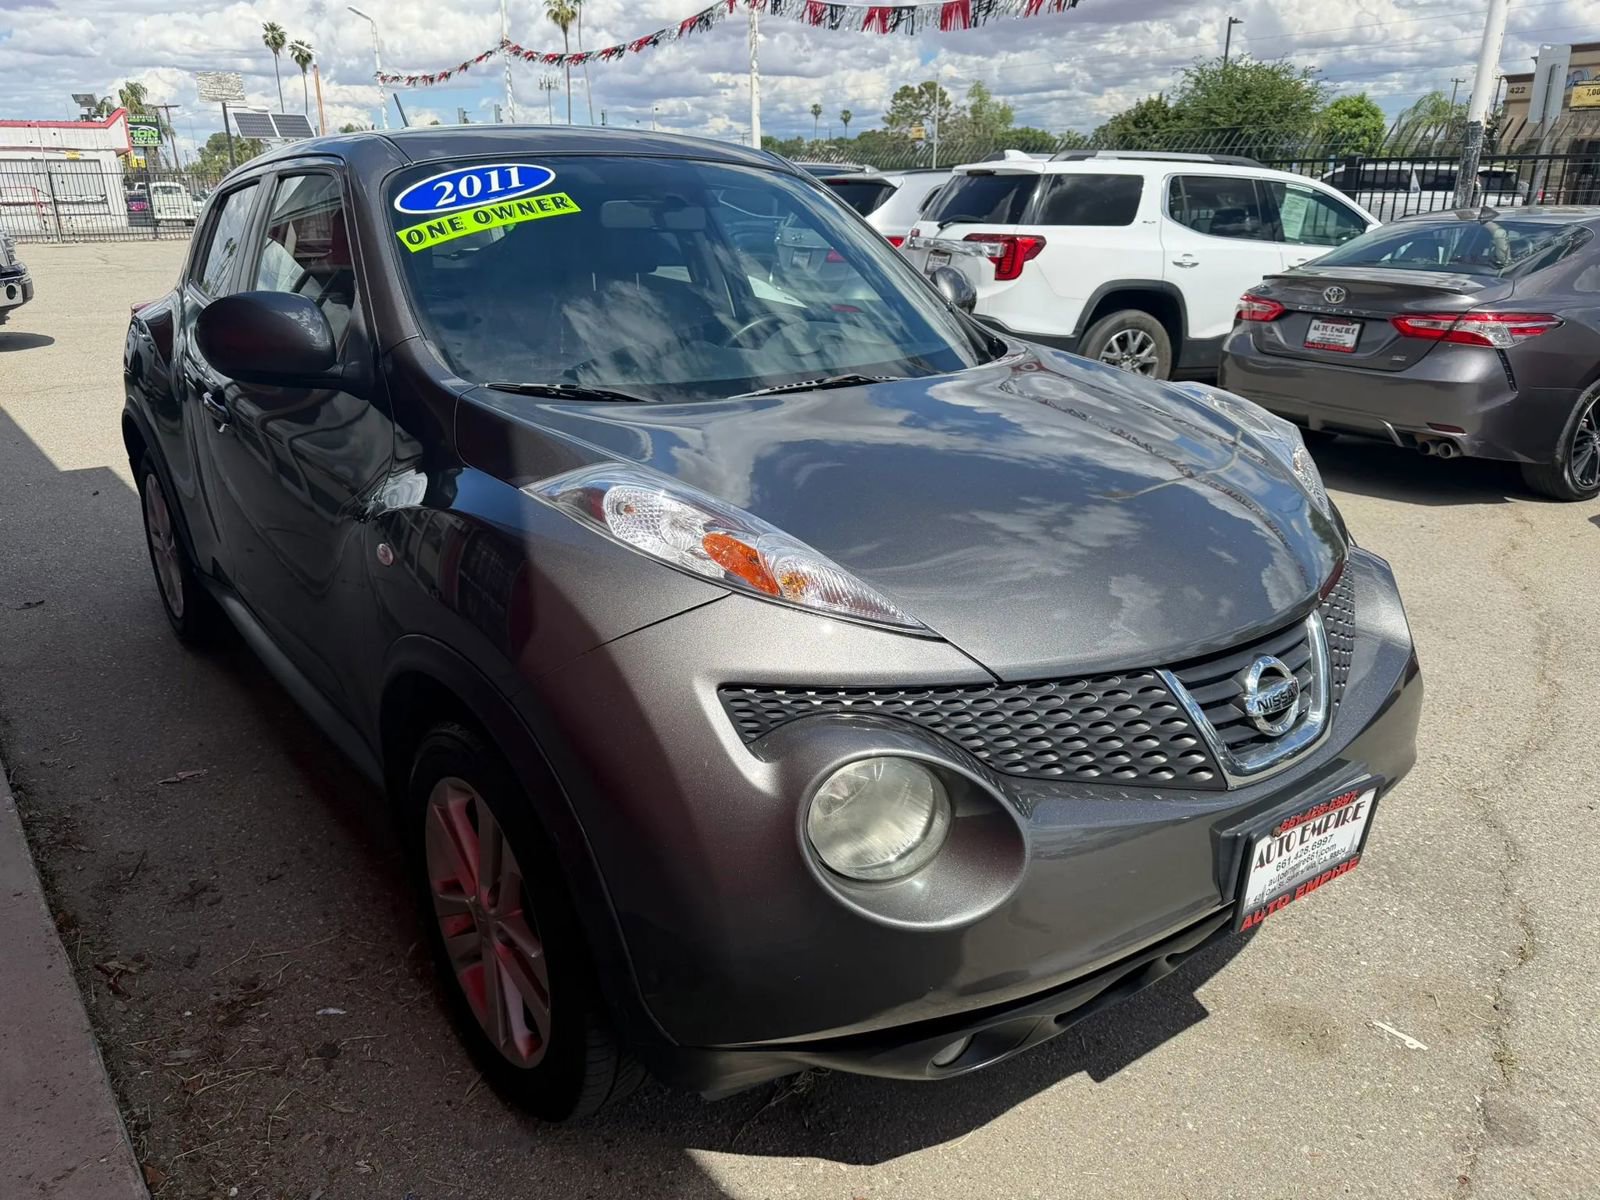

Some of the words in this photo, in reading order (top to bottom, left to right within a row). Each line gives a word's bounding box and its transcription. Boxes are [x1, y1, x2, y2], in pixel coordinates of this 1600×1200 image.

[1509, 86, 1526, 95] 422
[432, 166, 525, 207] 2011
[405, 216, 467, 246] ONE
[472, 196, 574, 226] OWNER
[1256, 680, 1298, 711] NISSAN
[1253, 830, 1297, 872] AUTO
[1299, 800, 1366, 846] EMPIRE
[1275, 833, 1334, 872] 661.428.6997
[1240, 893, 1291, 932] AUTO
[1295, 856, 1360, 901] EMPIRE
